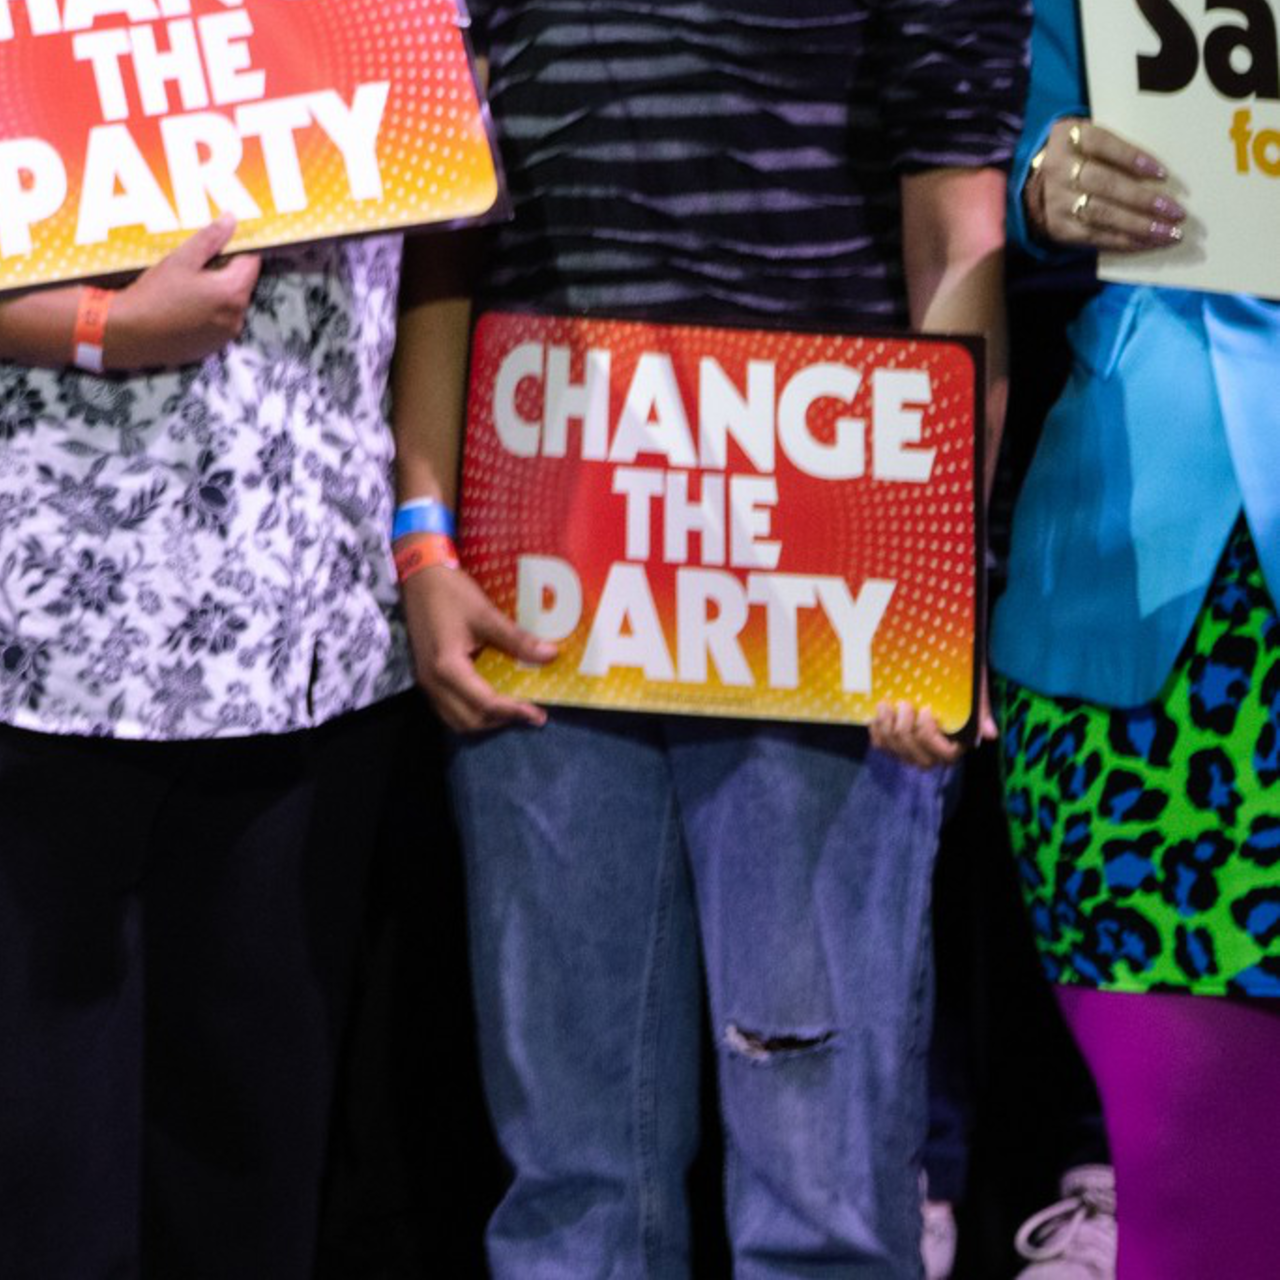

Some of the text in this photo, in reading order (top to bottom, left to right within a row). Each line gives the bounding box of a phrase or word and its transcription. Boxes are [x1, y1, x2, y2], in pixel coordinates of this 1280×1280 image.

[70, 7, 266, 123] THE
[491, 341, 938, 484] CHANGE
[611, 465, 783, 570] THE
[514, 552, 898, 696] PARTY
